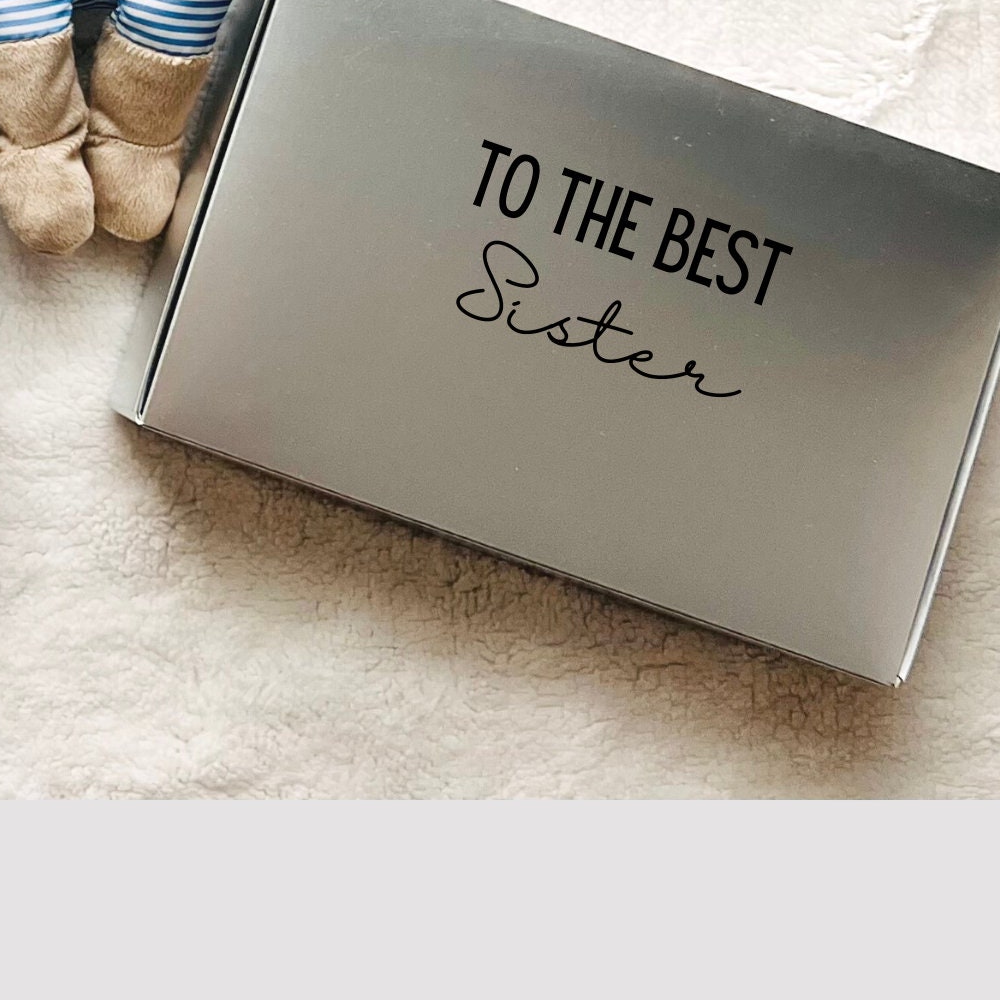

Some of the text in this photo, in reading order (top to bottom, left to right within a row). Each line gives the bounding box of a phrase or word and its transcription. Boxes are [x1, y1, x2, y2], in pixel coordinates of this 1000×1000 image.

[472, 139, 794, 306] TO THE BEST
[455, 240, 742, 398] Sister
